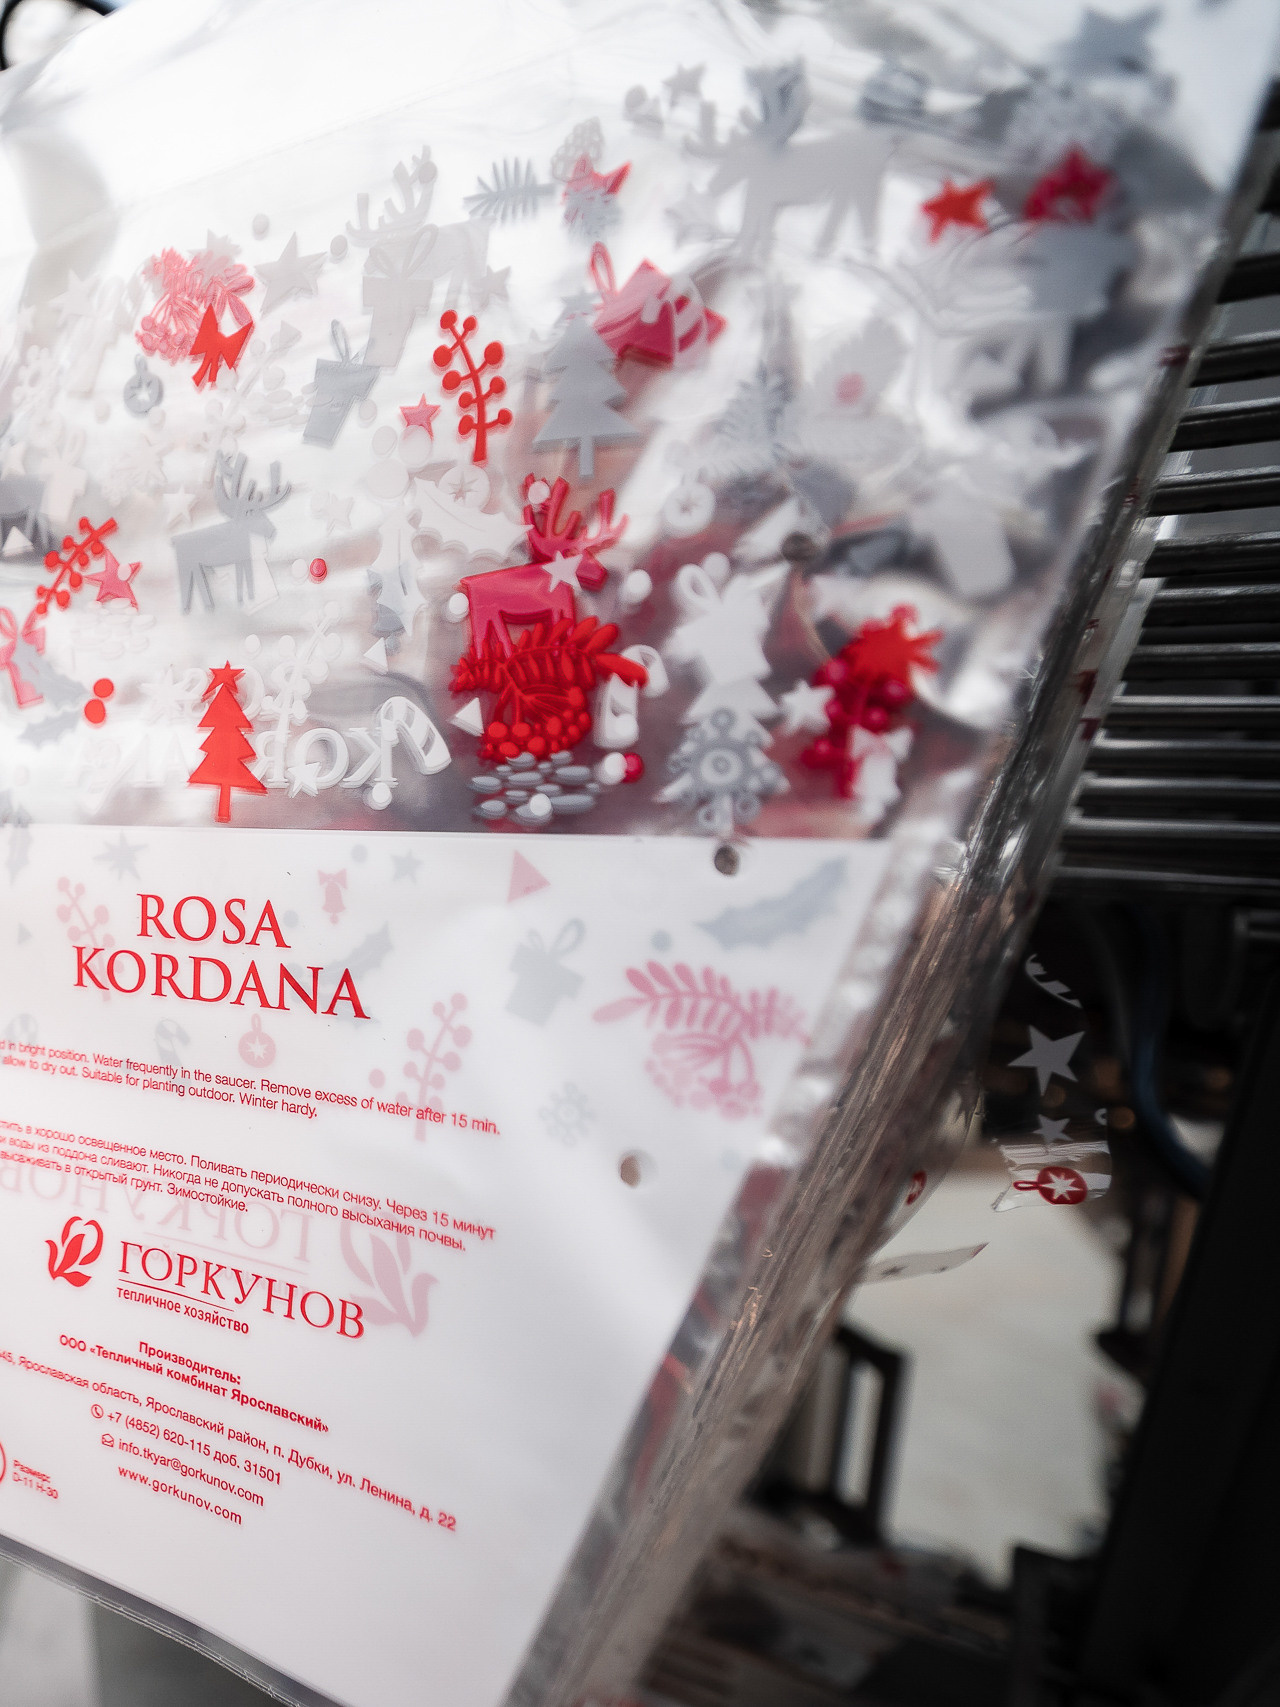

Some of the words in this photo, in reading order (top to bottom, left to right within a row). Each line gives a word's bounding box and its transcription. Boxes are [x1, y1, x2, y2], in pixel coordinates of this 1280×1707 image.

[136, 893, 291, 949] ROSA
[72, 945, 371, 1020] KORDANA
[2, 1053, 27, 1068] allow
[29, 1060, 39, 1070] to
[41, 1061, 57, 1075] dry
[59, 1065, 79, 1077] out.
[81, 1067, 123, 1084] Suitable
[125, 1074, 139, 1087] for
[142, 1077, 185, 1097] planting
[188, 1084, 235, 1103] outdoor.
[239, 1092, 279, 1111] Winter
[281, 1099, 318, 1119] hardy.
[8, 1042, 16, 1051] in
[18, 1043, 46, 1058] bright
[48, 1048, 90, 1063] position.
[93, 1053, 123, 1069] Water
[126, 1058, 178, 1079] frequently
[181, 1067, 191, 1079] in
[194, 1070, 212, 1083] the
[215, 1075, 256, 1089] saucer.
[261, 1079, 312, 1099] Remove
[314, 1090, 358, 1107] excess
[361, 1097, 374, 1110] of
[376, 1100, 413, 1117] water
[416, 1107, 447, 1124] after
[451, 1112, 468, 1128] 15
[472, 1118, 501, 1135] min.
[0, 1149, 62, 1172] высаживать
[65, 1163, 71, 1173] в
[74, 1165, 127, 1186] открытый
[131, 1175, 163, 1194] грунт.
[167, 1181, 248, 1213] Зимостойкие.
[8, 1136, 35, 1150] воды
[37, 1142, 50, 1154] из
[52, 1146, 97, 1165] поддона
[100, 1155, 149, 1174] сливают.
[153, 1164, 201, 1185] Никогда
[204, 1176, 218, 1188] не
[221, 1180, 284, 1204] допускать
[287, 1194, 338, 1217] полного
[342, 1207, 415, 1237] высыхания
[419, 1227, 466, 1252] почвы.
[26, 1125, 32, 1135] в
[35, 1126, 75, 1143] хорошо
[78, 1136, 147, 1157] освещенное
[149, 1149, 187, 1165] место.
[191, 1155, 248, 1178] Поливать
[251, 1169, 340, 1199] периодически
[343, 1190, 382, 1210] снизу.
[386, 1198, 428, 1222] Через
[433, 1211, 449, 1227] 15
[452, 1219, 496, 1240] минут
[117, 1287, 181, 1314] тепличное
[184, 1303, 249, 1335] хозяйство
[118, 1241, 365, 1340] ГОРКУНОВ
[59, 1334, 87, 1351] ООО
[90, 1344, 163, 1375] «Тепличный
[166, 1367, 228, 1398] комбинат
[231, 1388, 329, 1434] Ярославский»
[139, 1341, 241, 1385] Производитель:
[18, 1355, 89, 1389] Ярославская
[92, 1381, 142, 1407] область,
[146, 1397, 224, 1435] Ярославский
[227, 1425, 270, 1454] район,
[273, 1445, 285, 1459] п.
[288, 1449, 333, 1480] Дубки,
[337, 1469, 356, 1488] ул.
[360, 1478, 416, 1515] Ленина,
[420, 1506, 433, 1523] д.
[437, 1511, 457, 1532] 22
[107, 1411, 122, 1424] +7
[125, 1415, 160, 1439] (4852)
[163, 1429, 211, 1457] 620-115
[213, 1450, 240, 1469] доб.
[243, 1460, 281, 1485] 31501
[118, 1438, 264, 1507] info.tkyar@gorkunov.com
[118, 1466, 242, 1525] www.gorkunov.com
